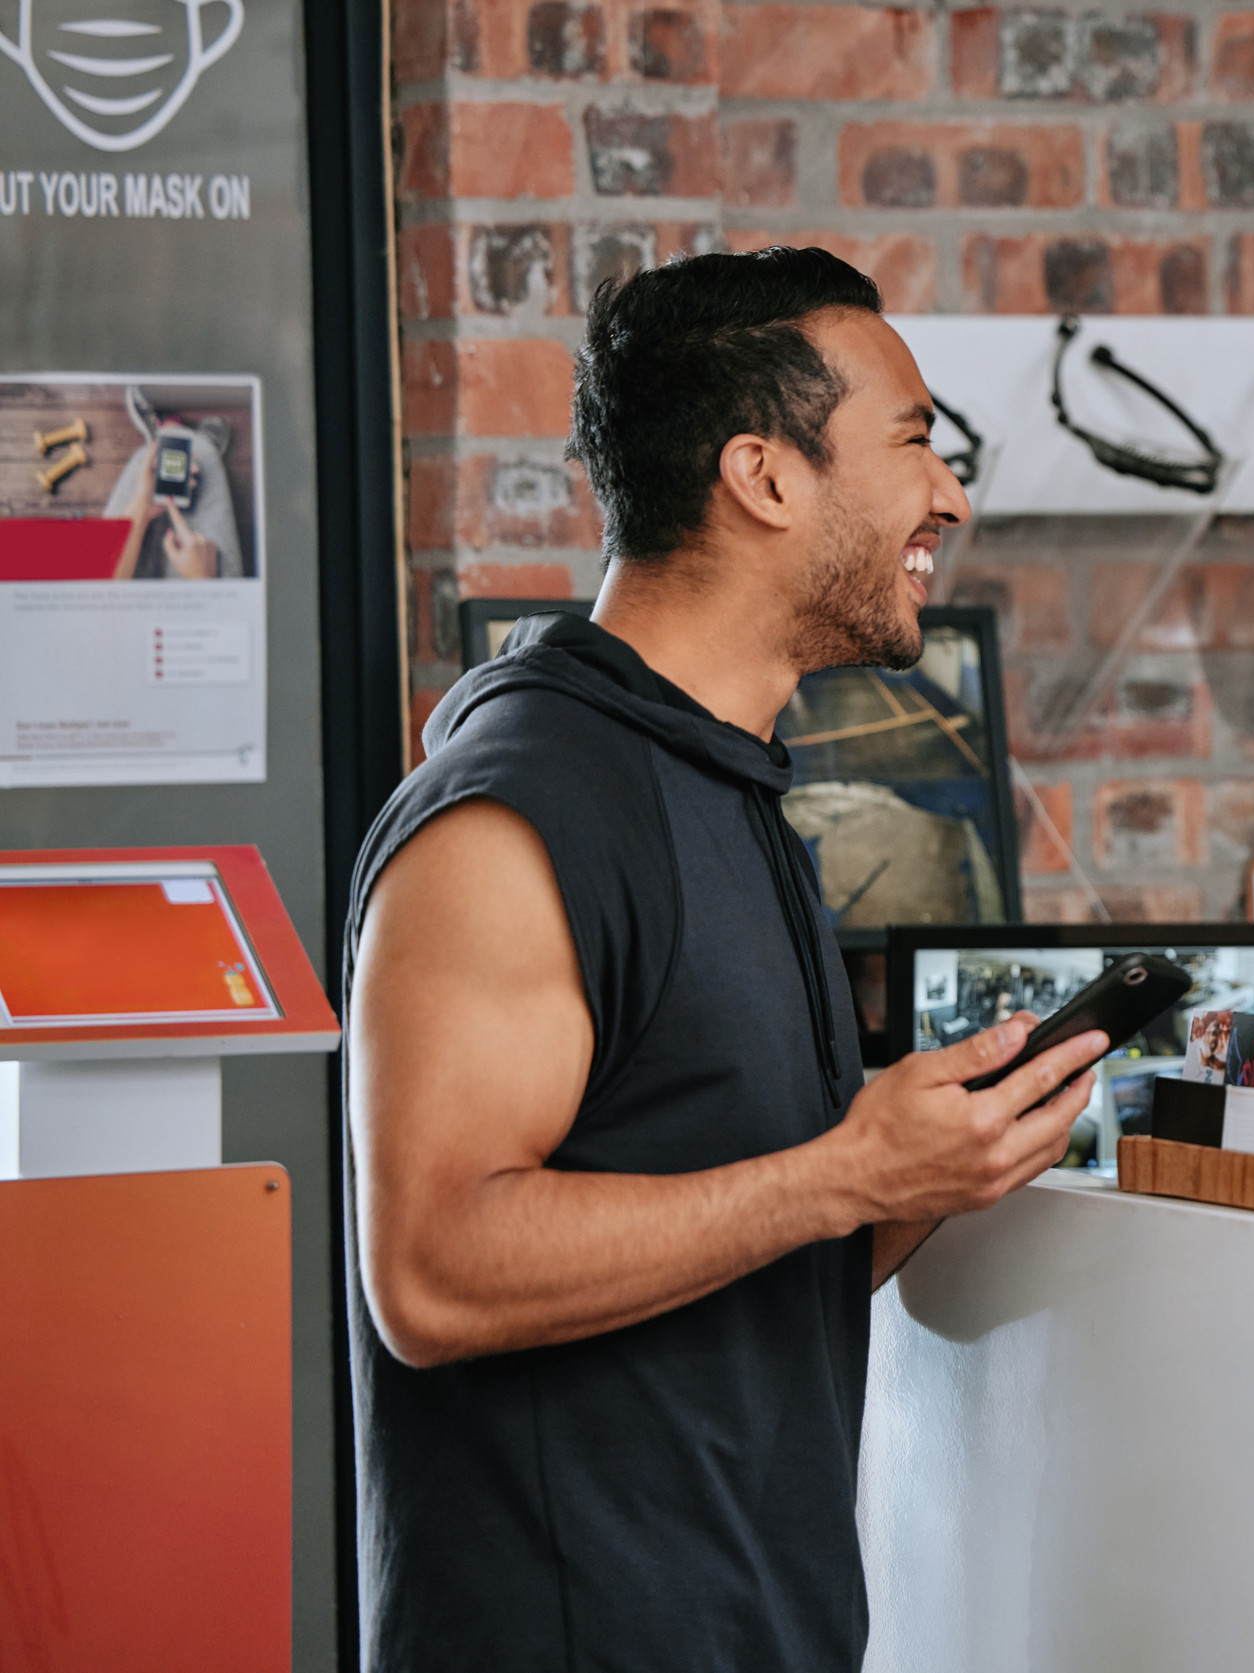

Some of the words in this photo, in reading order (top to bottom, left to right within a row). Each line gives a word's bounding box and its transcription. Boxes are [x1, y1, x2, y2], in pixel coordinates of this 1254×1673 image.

[39, 171, 120, 217] YOUR
[124, 172, 204, 219] MASK
[209, 174, 250, 220] ON
